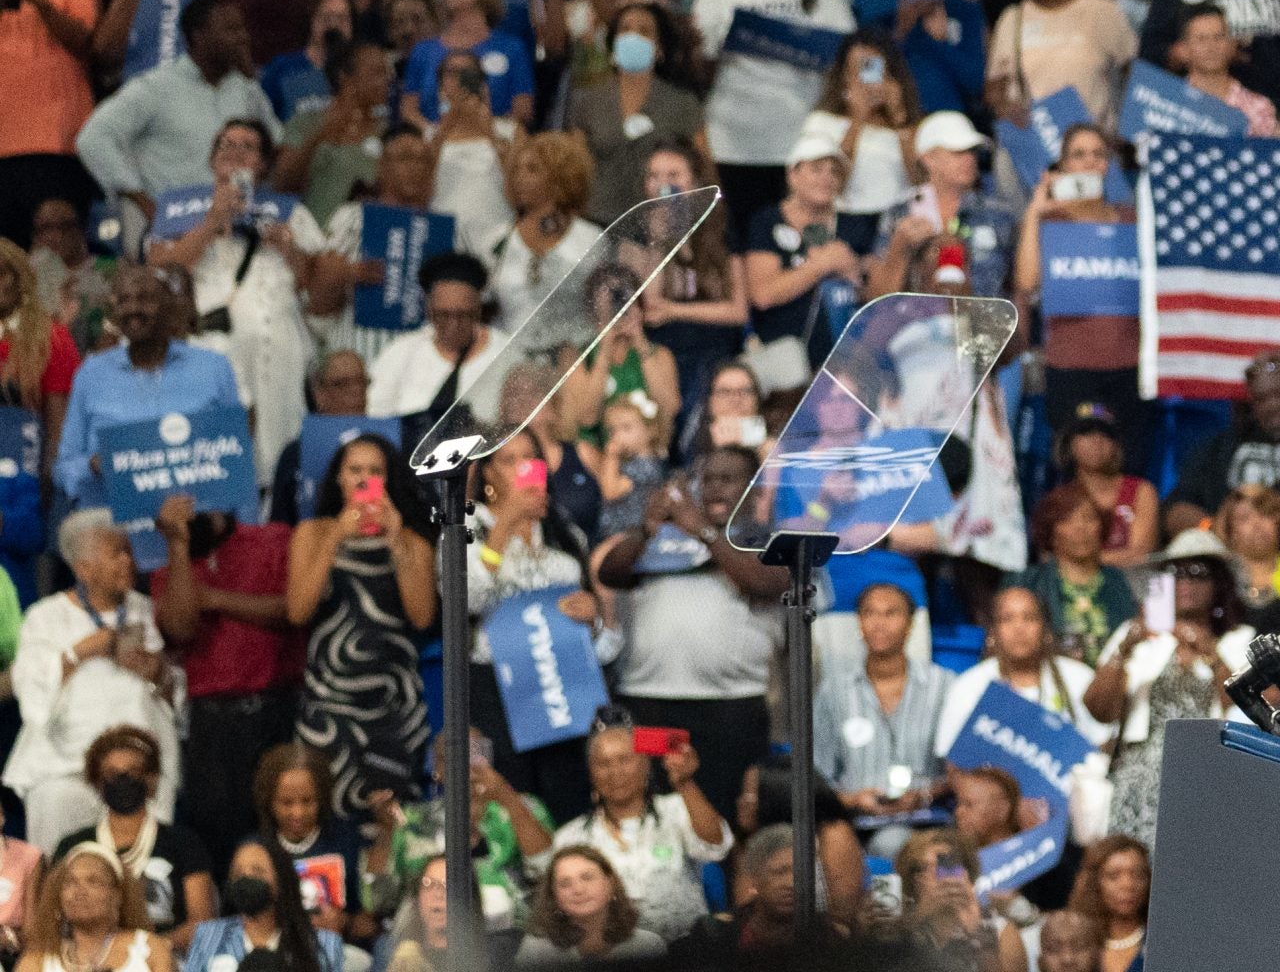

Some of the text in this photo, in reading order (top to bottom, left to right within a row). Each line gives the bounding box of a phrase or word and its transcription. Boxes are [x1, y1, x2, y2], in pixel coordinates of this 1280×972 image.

[1049, 256, 1140, 280] KAMAL
[112, 448, 165, 474] When
[165, 445, 193, 465] we
[133, 459, 229, 493] WE WIN.
[521, 601, 573, 729] KAMALA
[973, 714, 1072, 794] KAMAL
